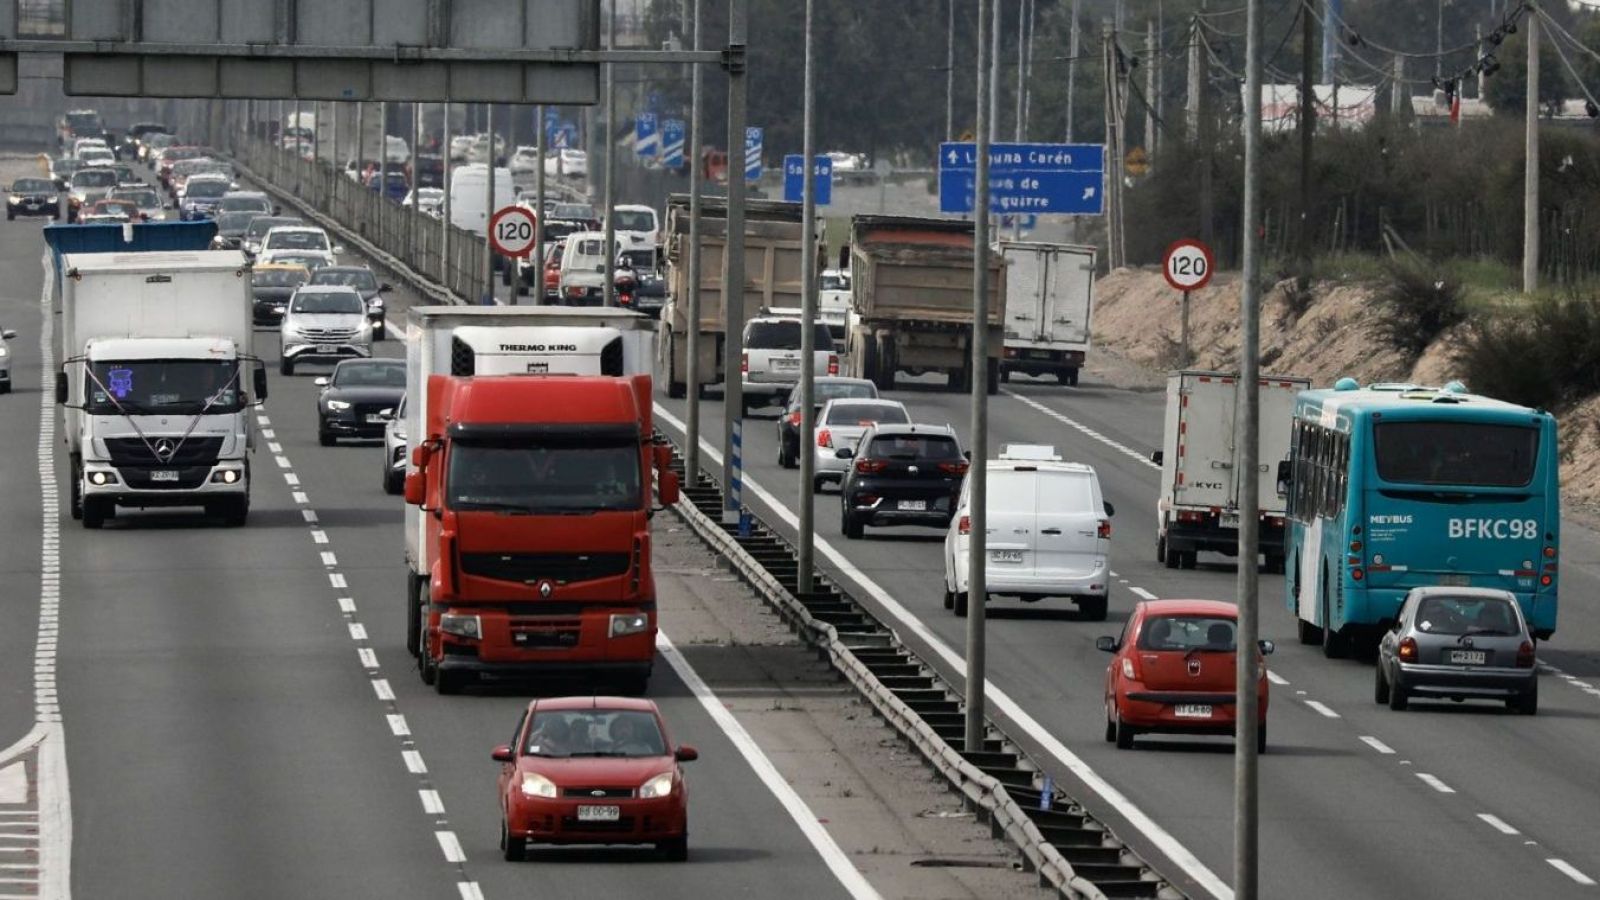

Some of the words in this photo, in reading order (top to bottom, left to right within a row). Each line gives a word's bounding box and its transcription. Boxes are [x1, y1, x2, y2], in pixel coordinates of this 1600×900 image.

[966, 152, 1021, 166] Luna
[1029, 151, 1072, 164] Carén
[789, 164, 828, 176] Sada
[1020, 177, 1040, 189] de
[498, 222, 531, 240] 120
[1173, 256, 1206, 276] 120
[1448, 518, 1537, 539] BFKC98
